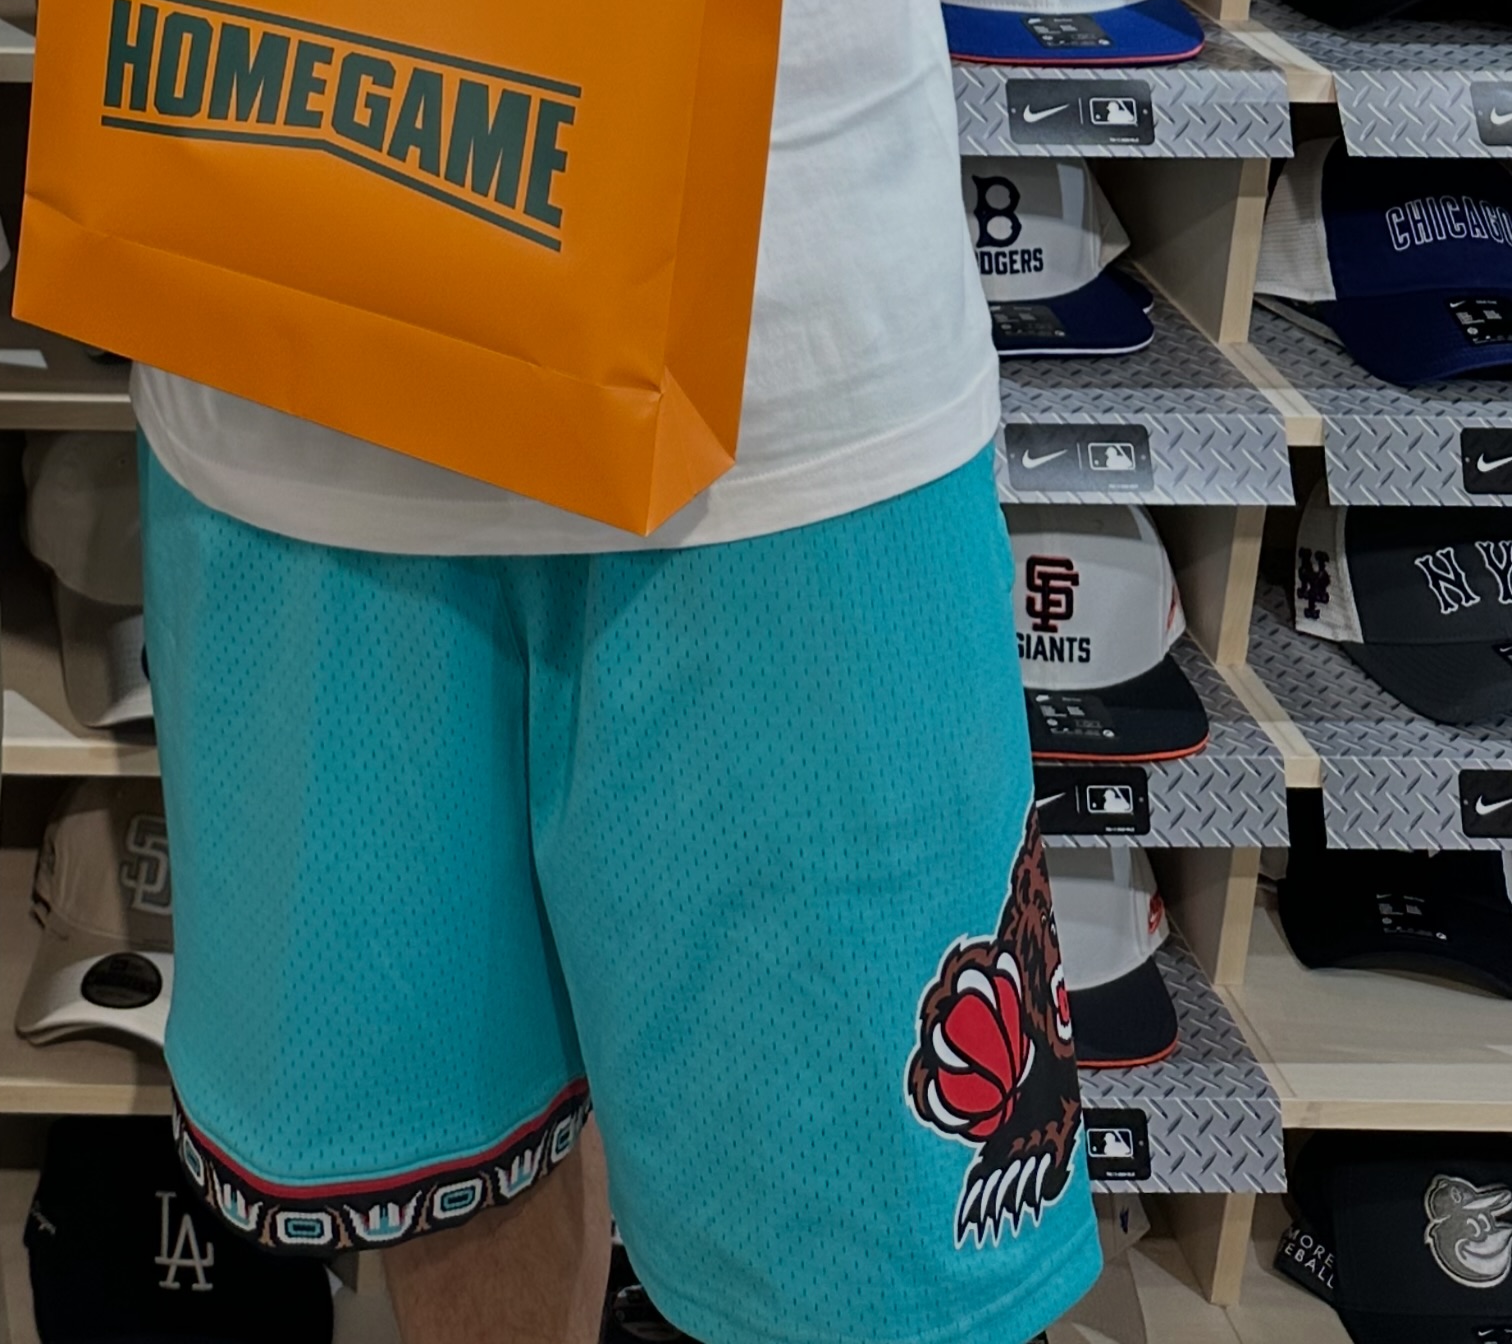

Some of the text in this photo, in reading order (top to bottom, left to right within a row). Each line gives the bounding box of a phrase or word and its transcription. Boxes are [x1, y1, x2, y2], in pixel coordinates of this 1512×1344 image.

[972, 174, 1023, 249] B
[977, 248, 1044, 276] DGERS
[154, 1190, 215, 1291] LA
